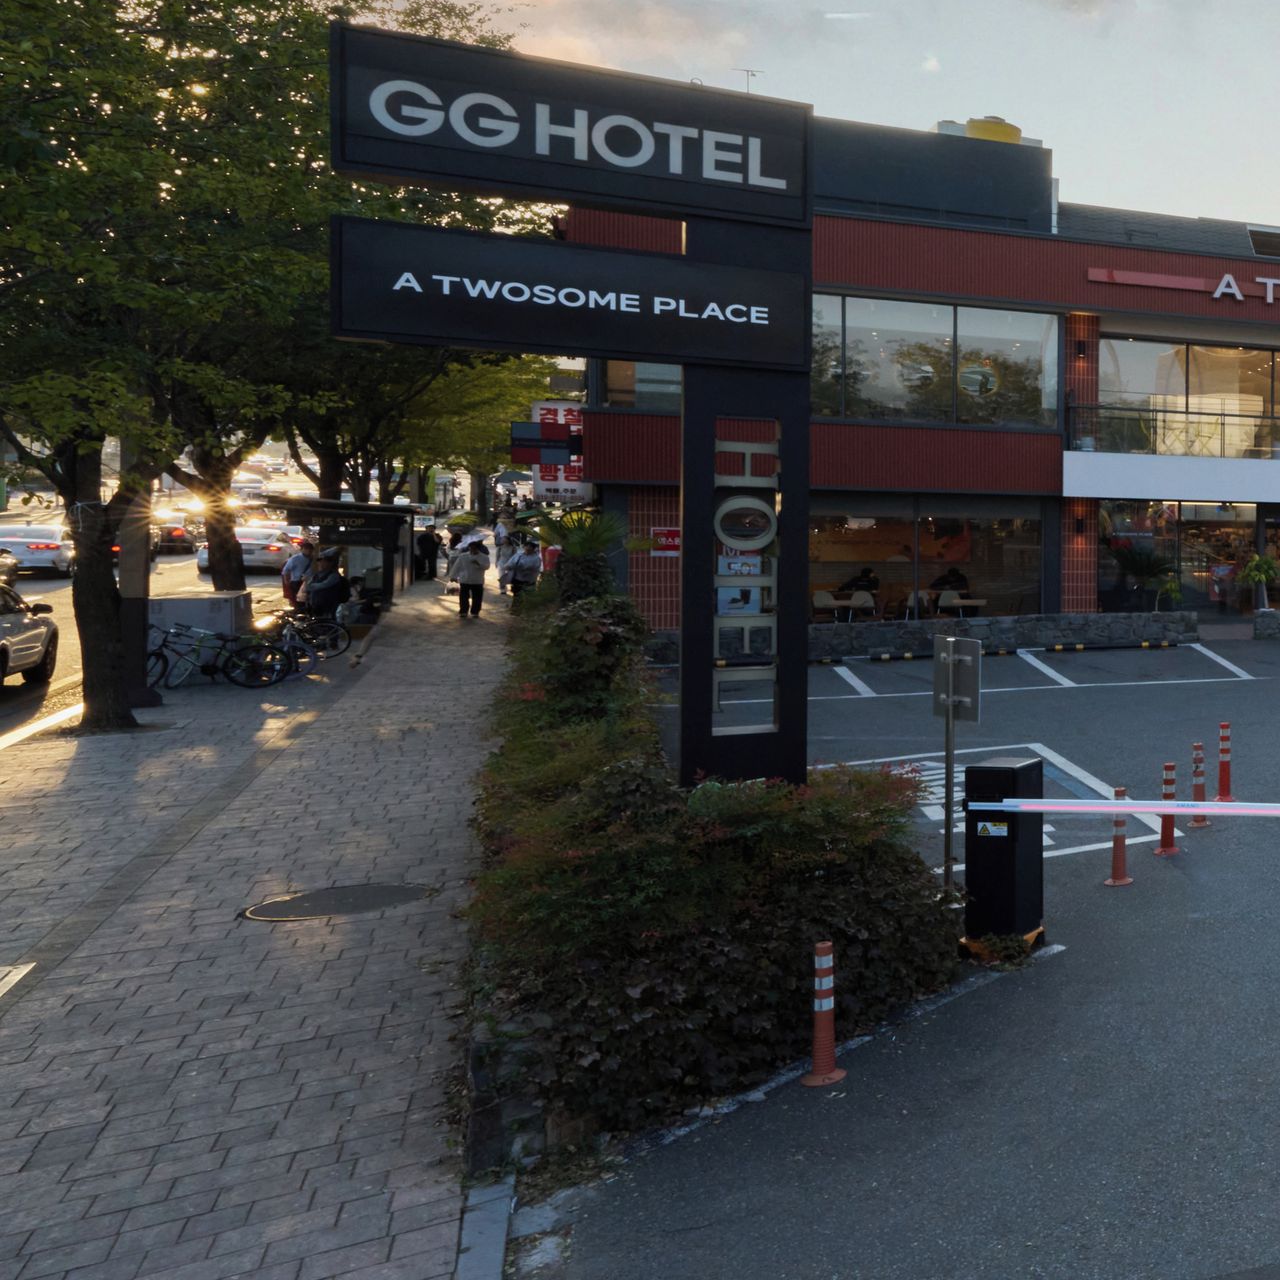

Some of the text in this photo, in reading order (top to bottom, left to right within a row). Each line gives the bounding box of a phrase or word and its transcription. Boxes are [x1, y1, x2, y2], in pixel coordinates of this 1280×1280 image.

[369, 79, 787, 190] GG HOTEL
[392, 272, 769, 325] A TWOSOME PLACE
[1212, 274, 1244, 303] A
[312, 517, 365, 527] BUS STOP
[713, 441, 778, 736] HOTEL
